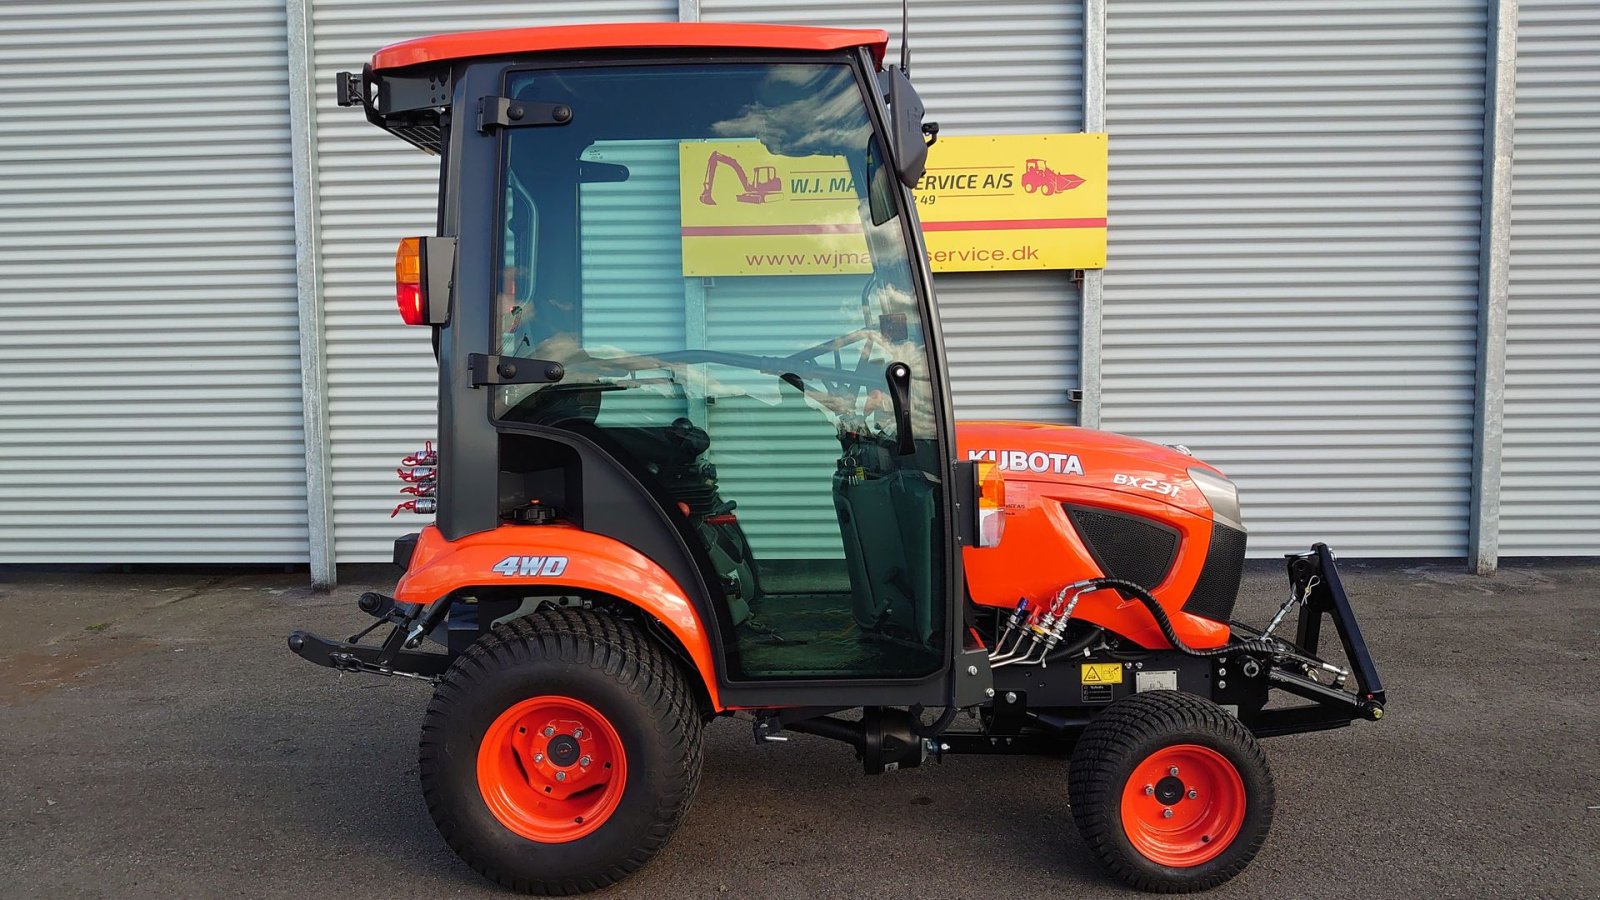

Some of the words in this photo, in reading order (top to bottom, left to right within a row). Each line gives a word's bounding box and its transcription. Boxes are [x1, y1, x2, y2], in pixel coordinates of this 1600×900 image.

[790, 178, 823, 193] W.J.
[982, 173, 1014, 189] A/S
[920, 195, 936, 205] 49
[492, 555, 569, 577] 4WD
